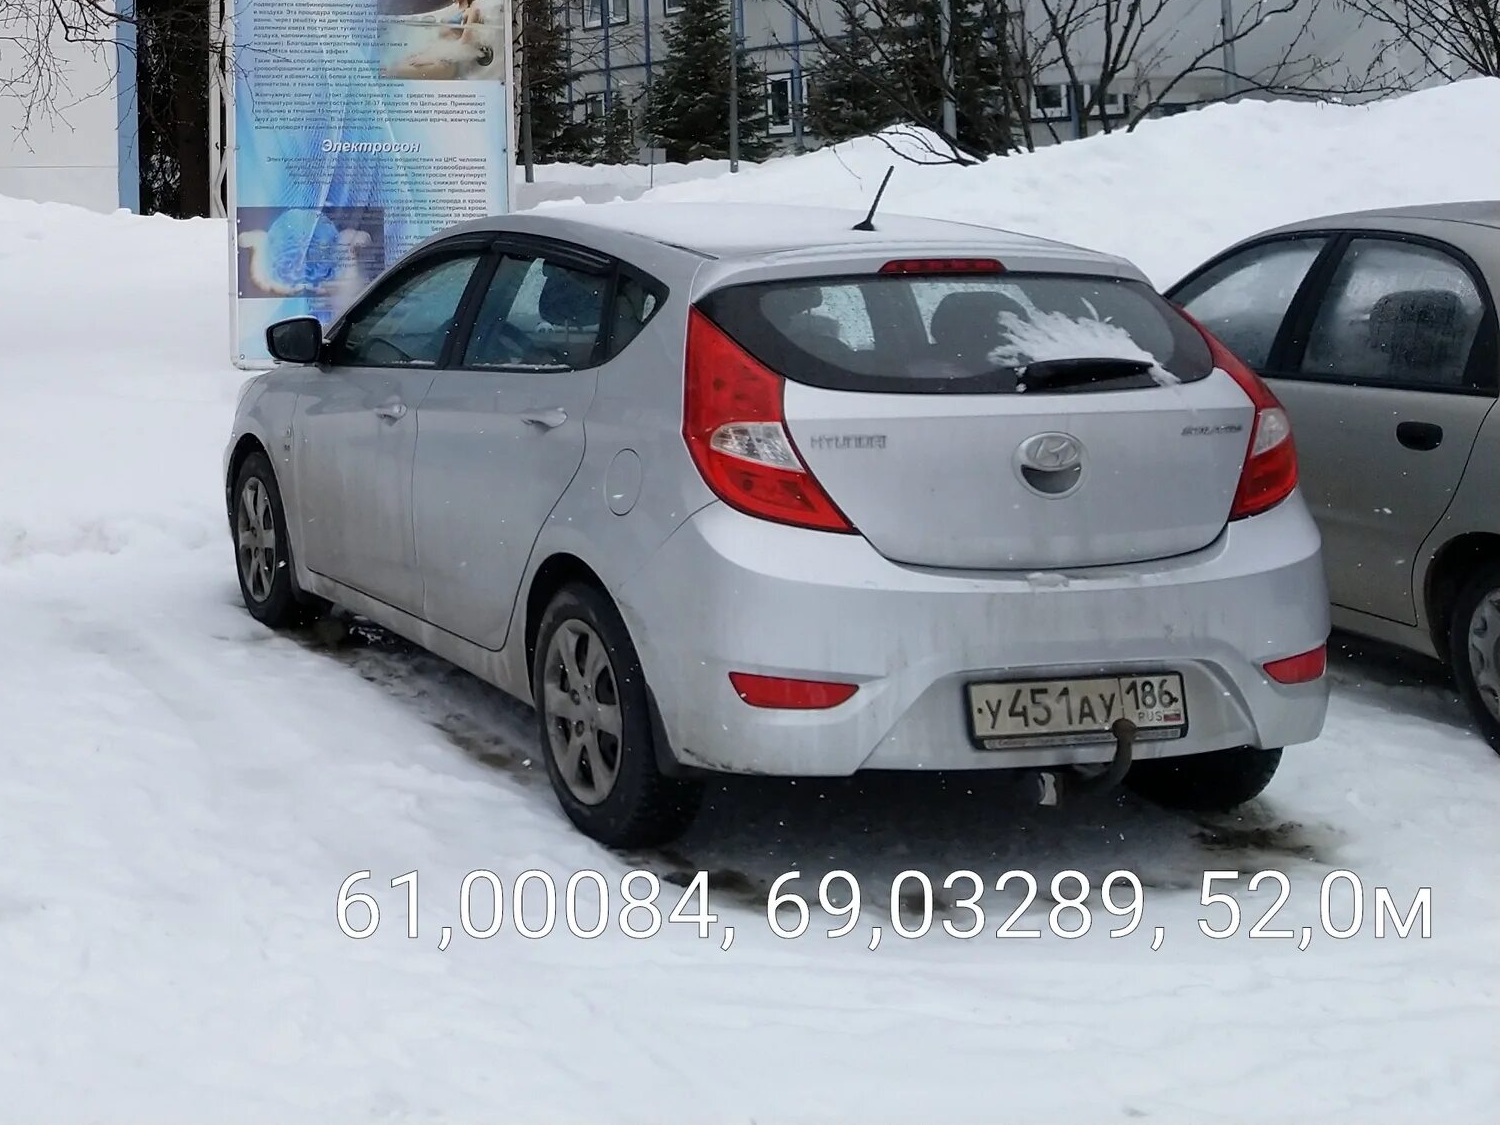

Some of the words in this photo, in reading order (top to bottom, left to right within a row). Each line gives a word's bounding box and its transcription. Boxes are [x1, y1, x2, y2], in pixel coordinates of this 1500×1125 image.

[322, 139, 422, 154] Электросон
[1125, 678, 1178, 711] 186
[1138, 711, 1163, 723] RUS
